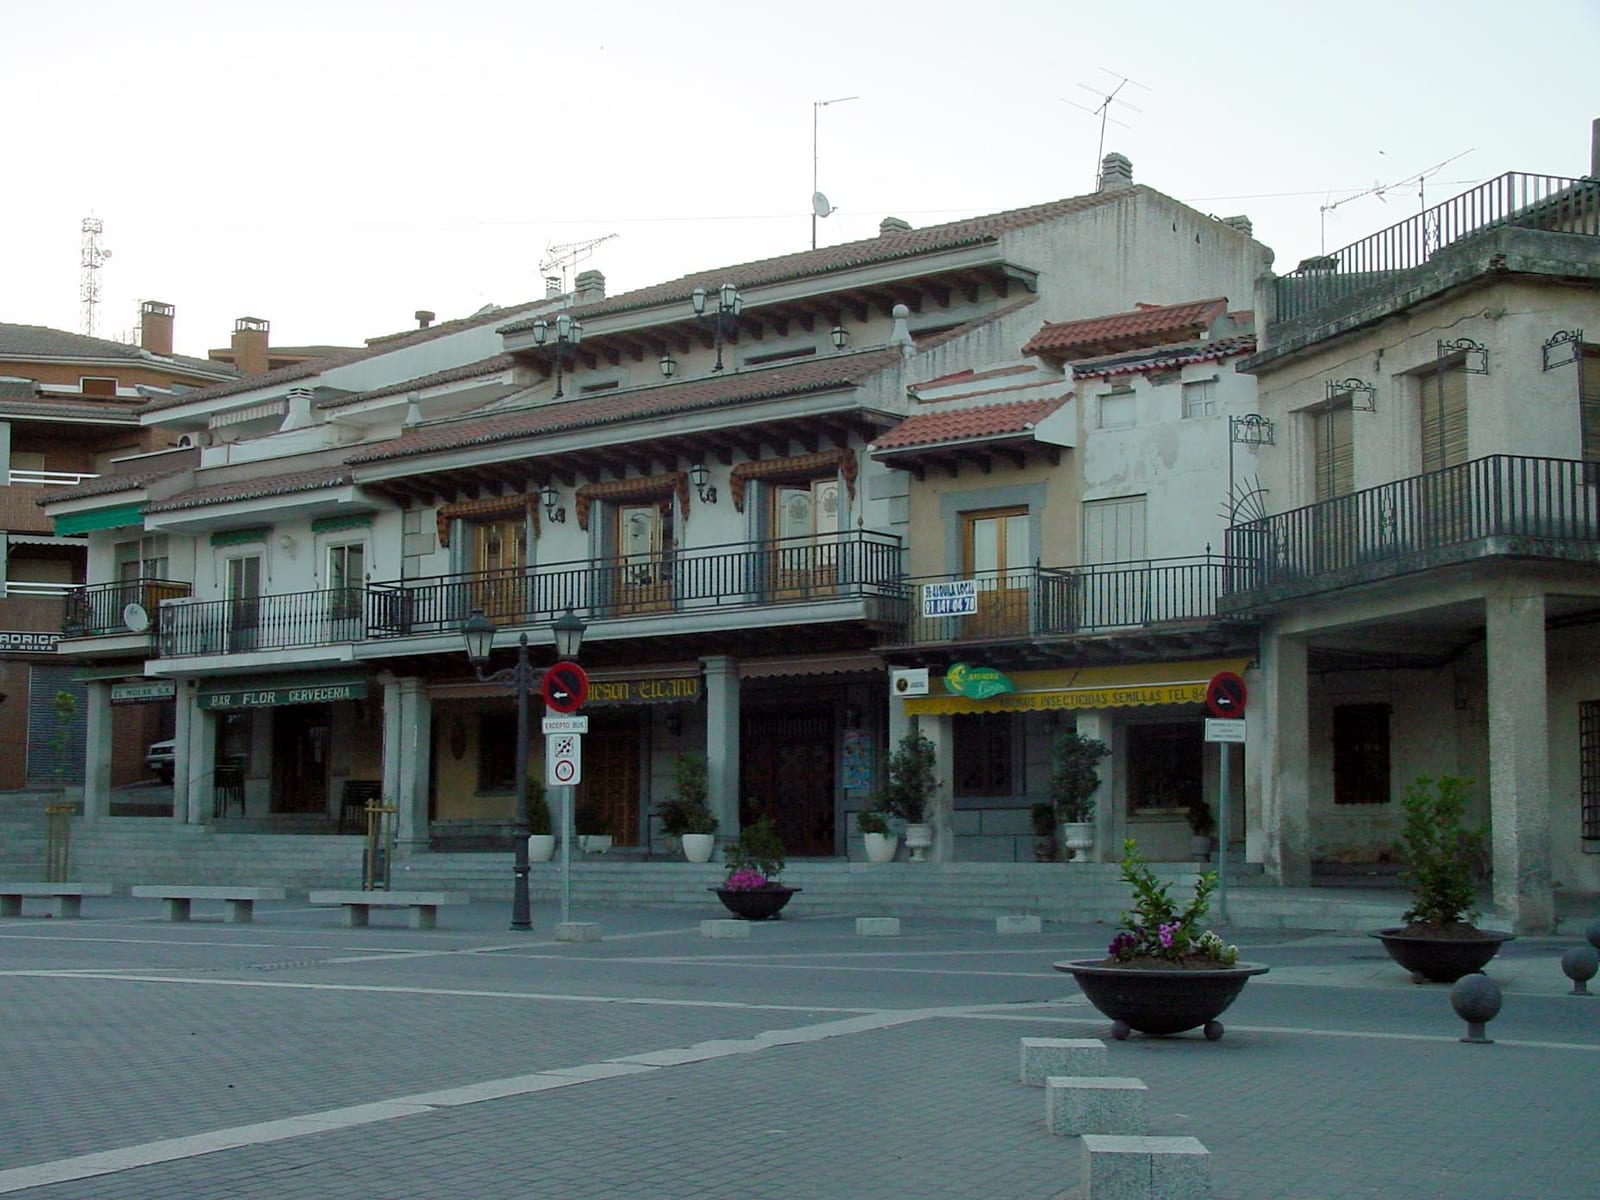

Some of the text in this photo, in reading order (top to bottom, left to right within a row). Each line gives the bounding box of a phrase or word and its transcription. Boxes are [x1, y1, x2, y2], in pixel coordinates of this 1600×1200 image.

[957, 581, 975, 595] LOCAL
[210, 687, 350, 706] BAR FLOR CERVECERIA
[1041, 692, 1107, 707] INSECTICIDAS
[1112, 689, 1162, 704] SEMILLAS
[1168, 688, 1186, 701] TEL
[545, 721, 584, 730] EXCEPTO BUS
